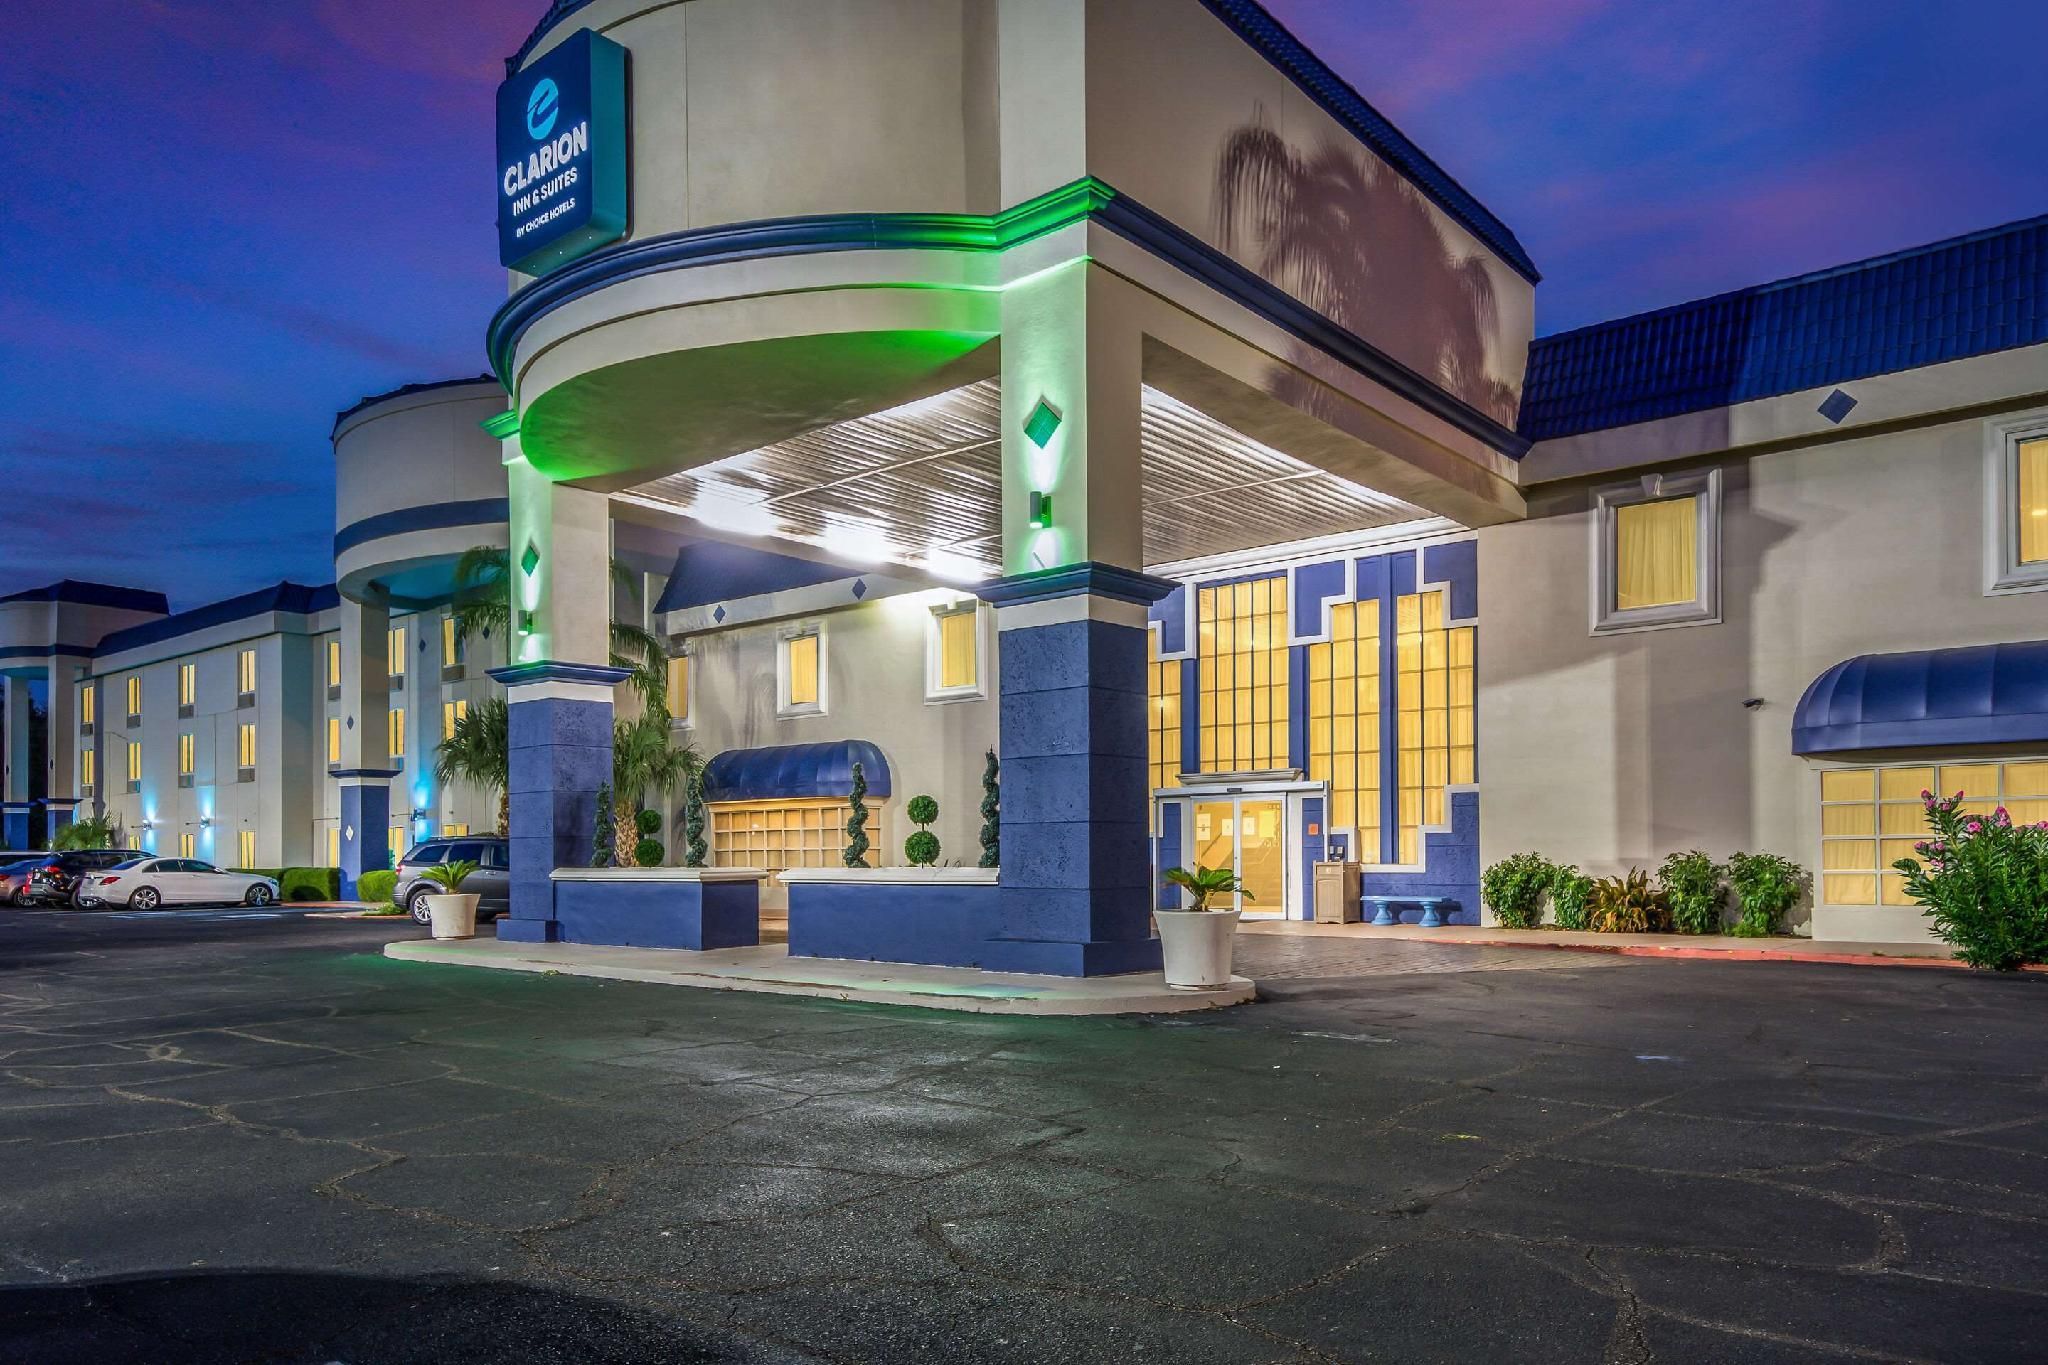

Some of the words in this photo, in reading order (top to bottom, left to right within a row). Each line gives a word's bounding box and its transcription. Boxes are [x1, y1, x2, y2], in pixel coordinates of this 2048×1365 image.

[503, 121, 588, 197] CLARION
[513, 194, 531, 217] INN
[532, 188, 541, 205] &
[540, 167, 577, 200] SUITES
[516, 225, 525, 238] BY
[525, 212, 550, 232] CHOICE
[549, 198, 576, 220] HOTELS
